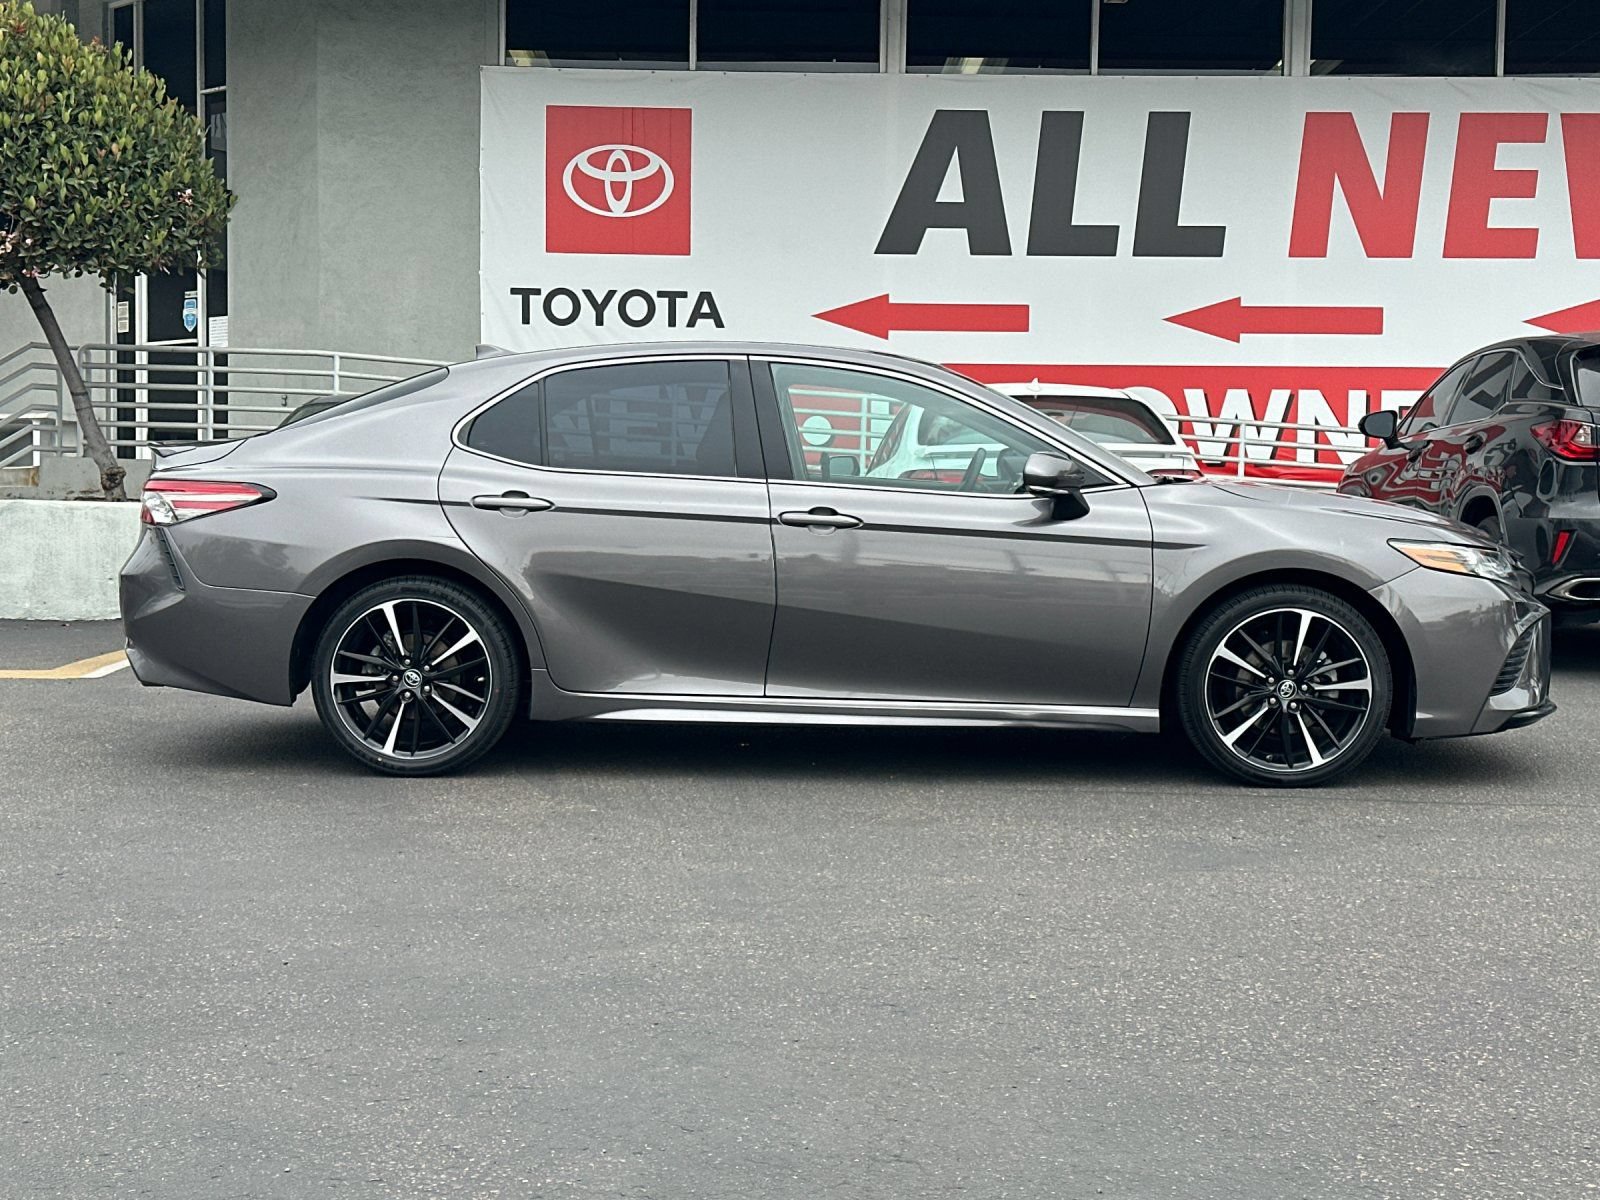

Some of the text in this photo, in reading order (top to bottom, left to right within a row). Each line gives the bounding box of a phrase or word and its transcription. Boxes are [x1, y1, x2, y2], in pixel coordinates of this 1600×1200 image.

[874, 110, 1600, 259] ALL NE
[510, 288, 724, 328] TOYOTA
